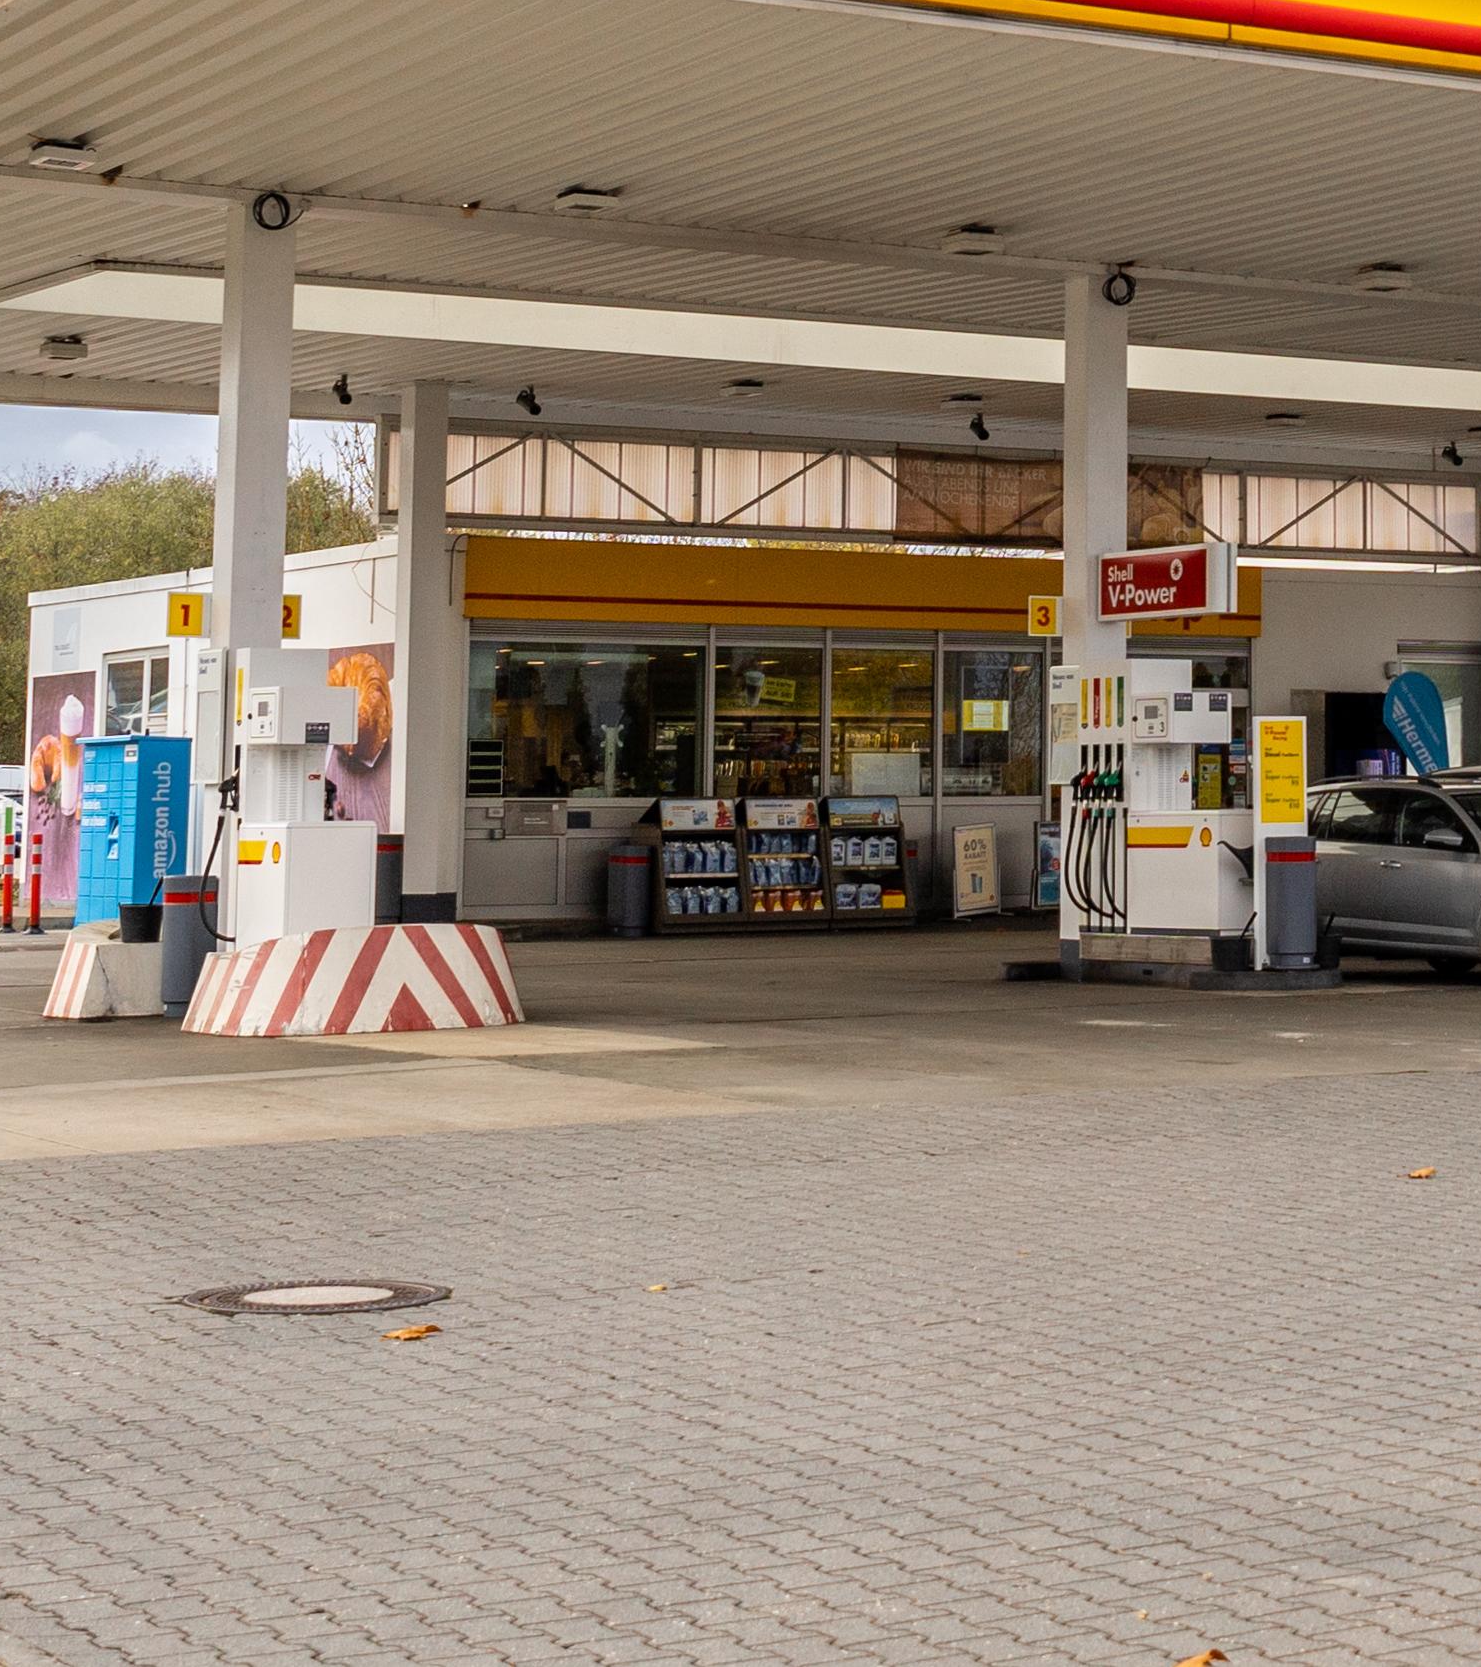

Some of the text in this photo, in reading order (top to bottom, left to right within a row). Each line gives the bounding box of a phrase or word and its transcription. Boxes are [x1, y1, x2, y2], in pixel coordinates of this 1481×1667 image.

[1107, 563, 1134, 583] Shell
[1107, 584, 1177, 608] V-Power
[180, 604, 191, 627] 1
[281, 604, 293, 628] 2
[1036, 605, 1051, 627] 3
[1159, 721, 1165, 733] 3
[151, 761, 172, 879] amazon hub
[963, 838, 987, 852] 60%
